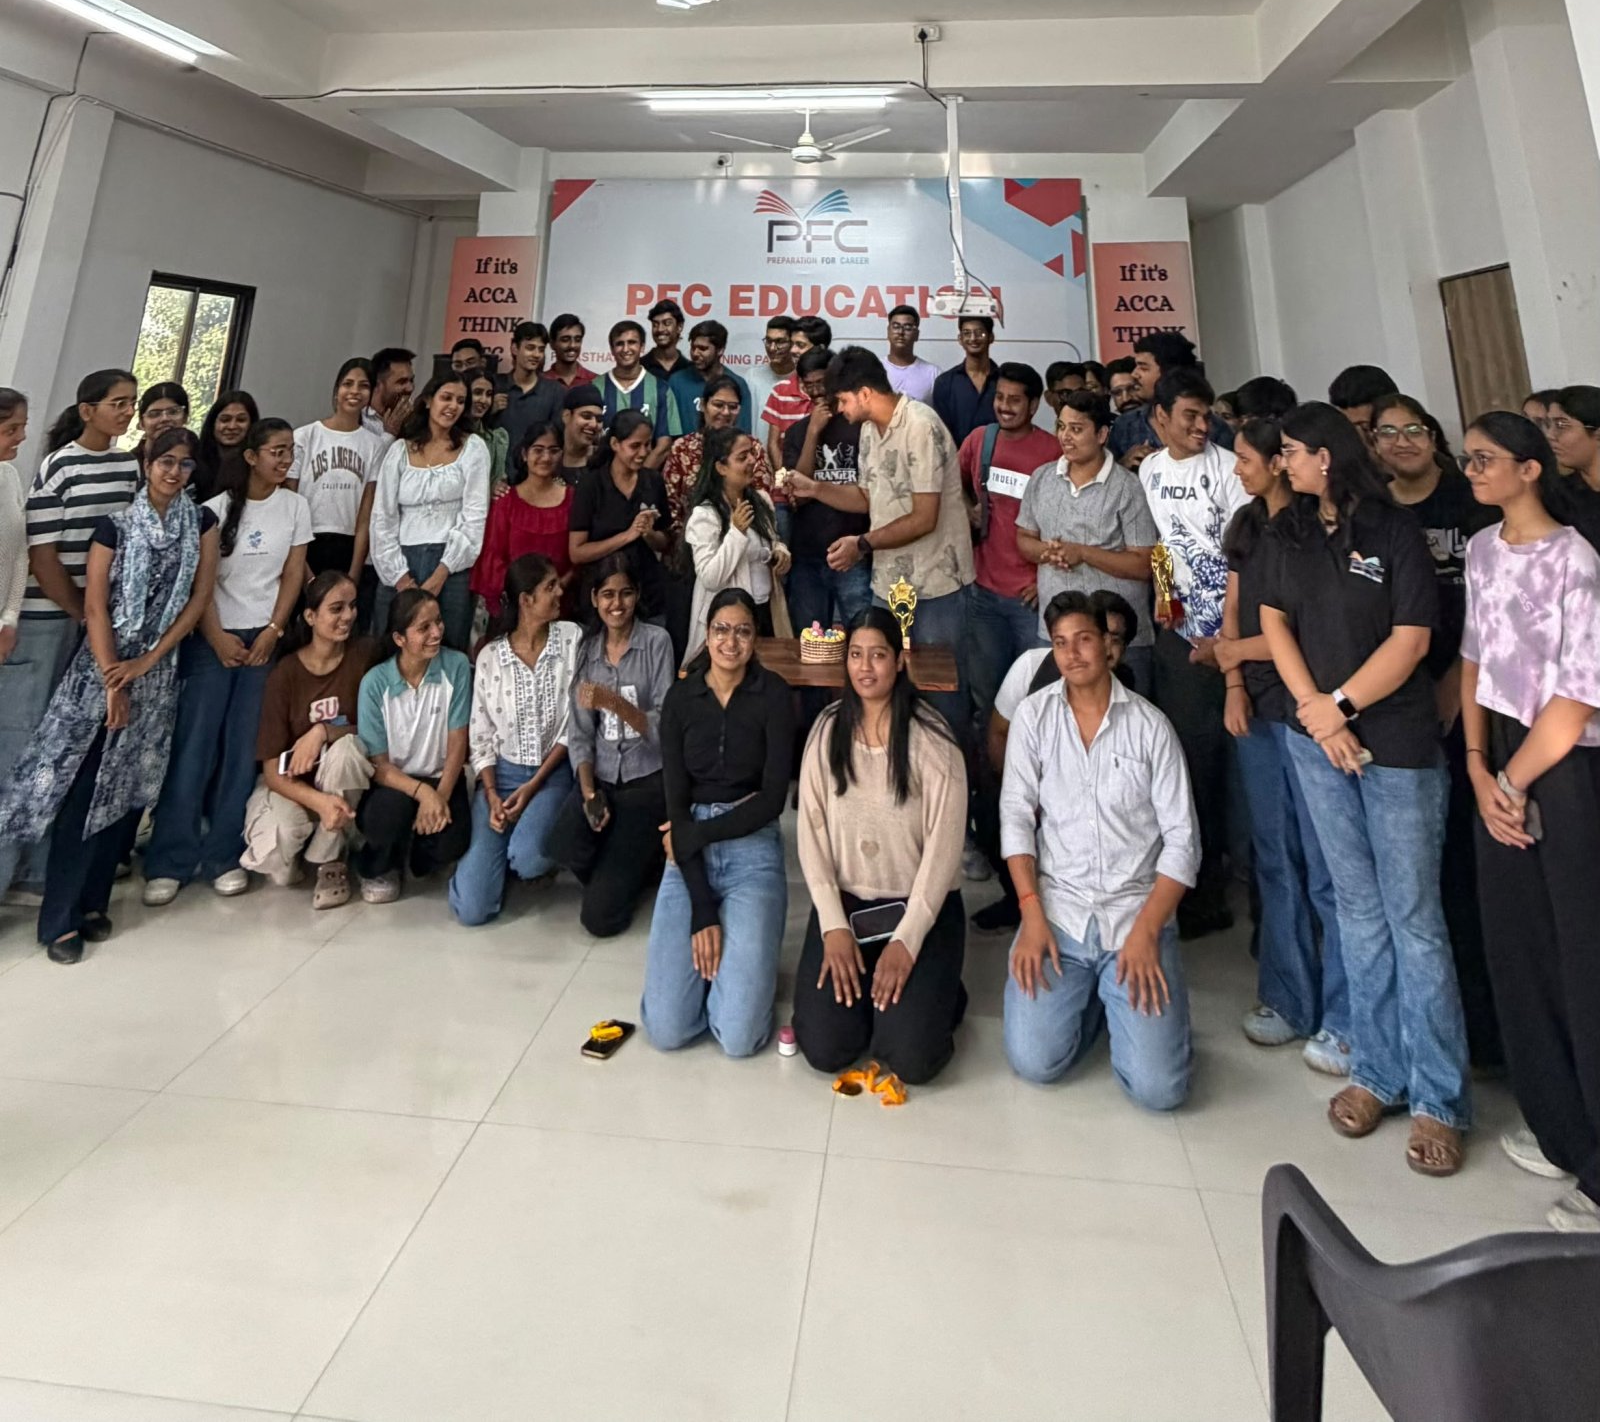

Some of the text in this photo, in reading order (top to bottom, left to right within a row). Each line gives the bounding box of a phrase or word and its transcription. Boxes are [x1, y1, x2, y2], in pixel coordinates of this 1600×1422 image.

[767, 220, 868, 253] PFC
[475, 257, 518, 274] If it's
[1119, 264, 1168, 281] If it's
[464, 287, 518, 303] ACCA
[1114, 295, 1175, 311] ACCA
[311, 450, 328, 482] LOS
[1161, 486, 1198, 500] INDIA
